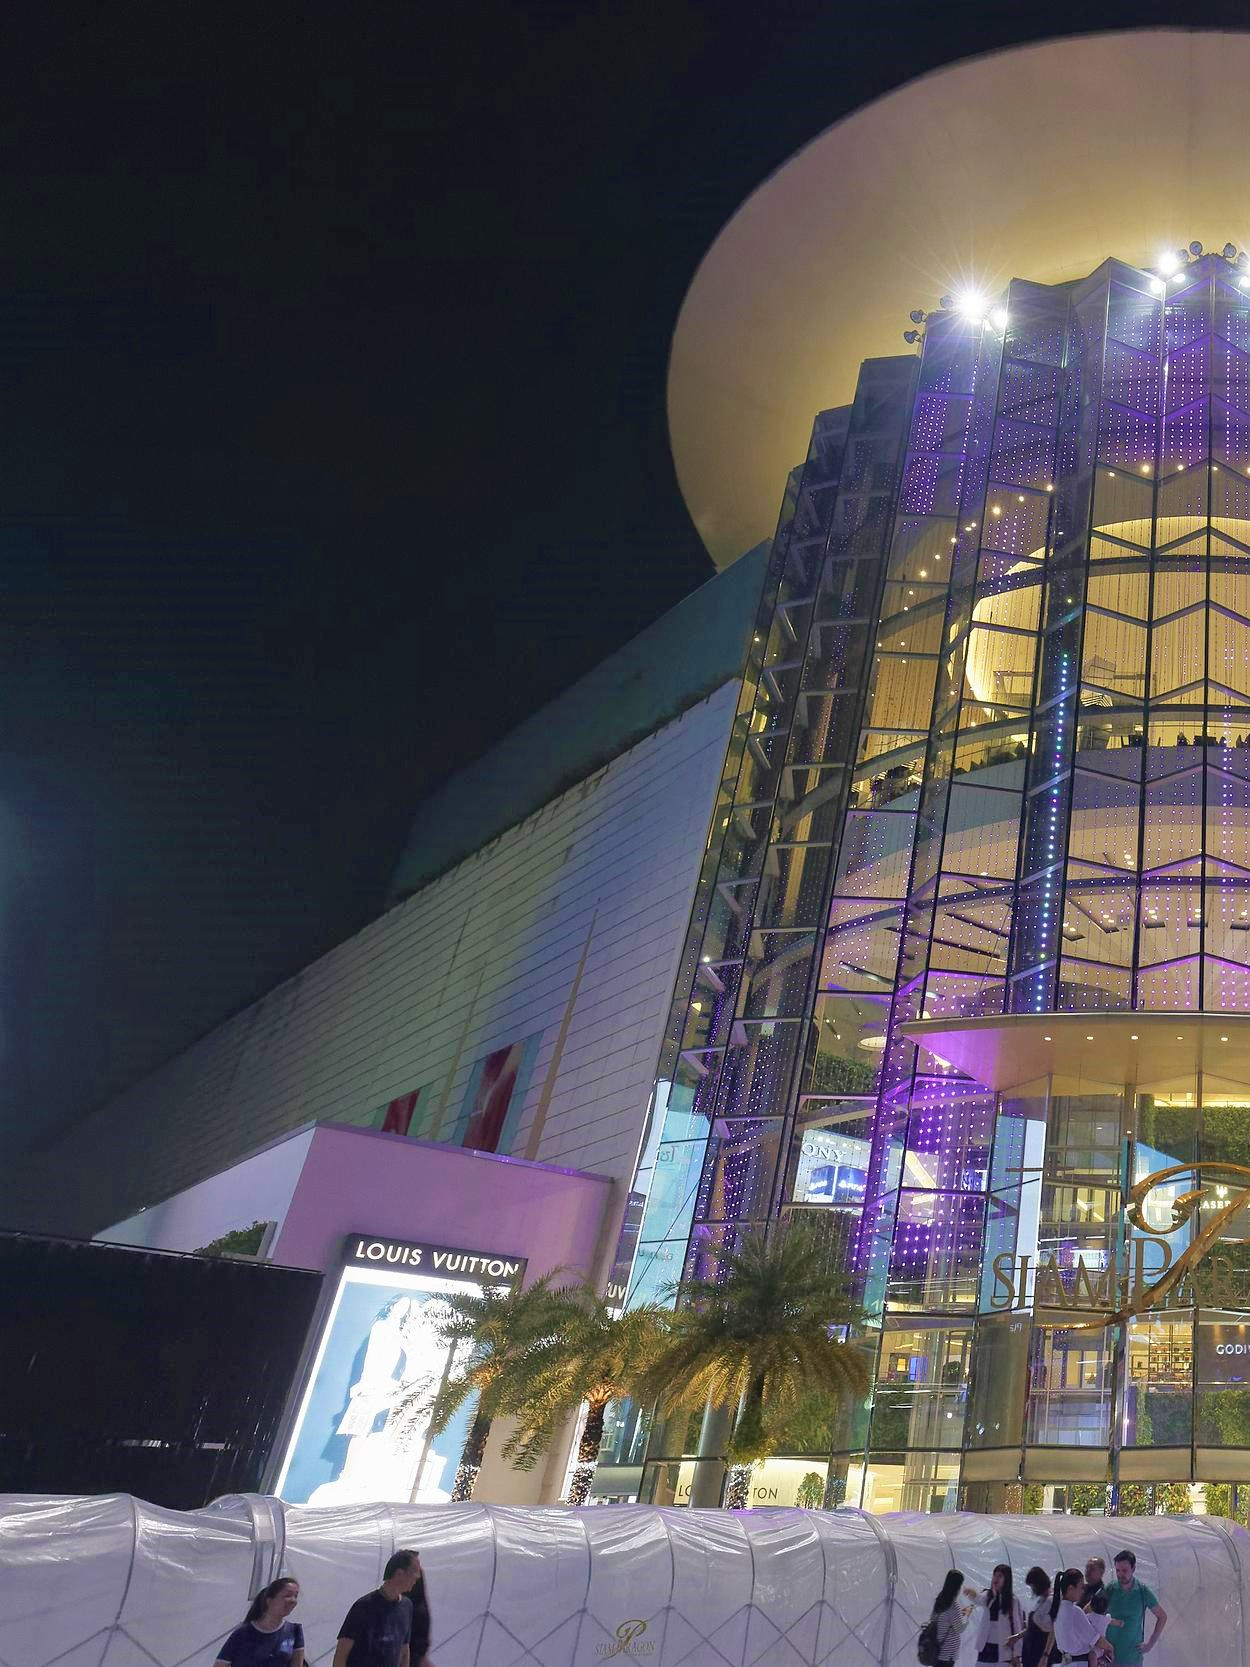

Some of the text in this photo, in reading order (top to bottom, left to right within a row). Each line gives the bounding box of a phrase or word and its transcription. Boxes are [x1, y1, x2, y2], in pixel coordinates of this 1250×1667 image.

[802, 1142, 847, 1164] ONY
[355, 1240, 519, 1278] LOUIS VUITTON
[990, 1249, 1118, 1309] SIAM
